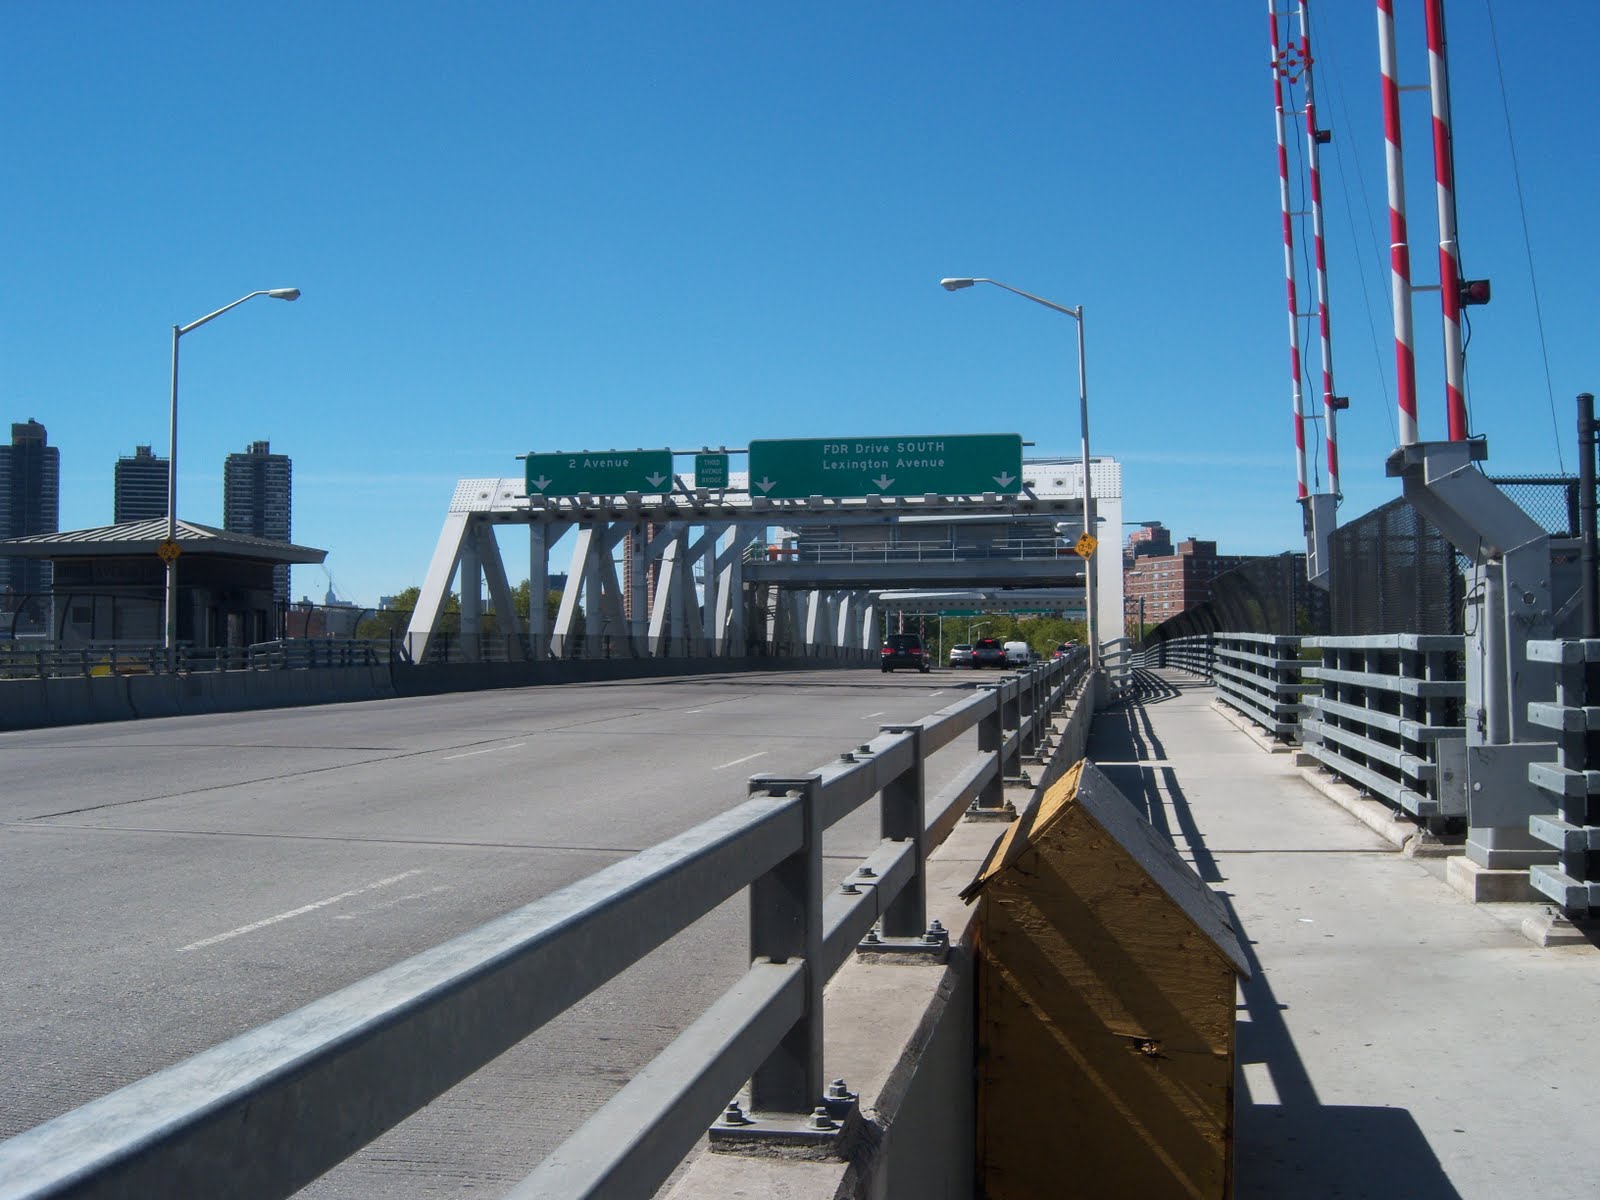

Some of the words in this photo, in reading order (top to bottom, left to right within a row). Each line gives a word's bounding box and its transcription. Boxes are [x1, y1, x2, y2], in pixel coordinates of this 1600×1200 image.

[823, 444, 849, 455] FDR
[855, 443, 890, 454] Drive
[897, 441, 945, 453] SOUTH
[568, 459, 576, 469] 2
[583, 458, 629, 469] Avenue
[823, 459, 889, 472] Lexington
[896, 457, 945, 468] Avenue
